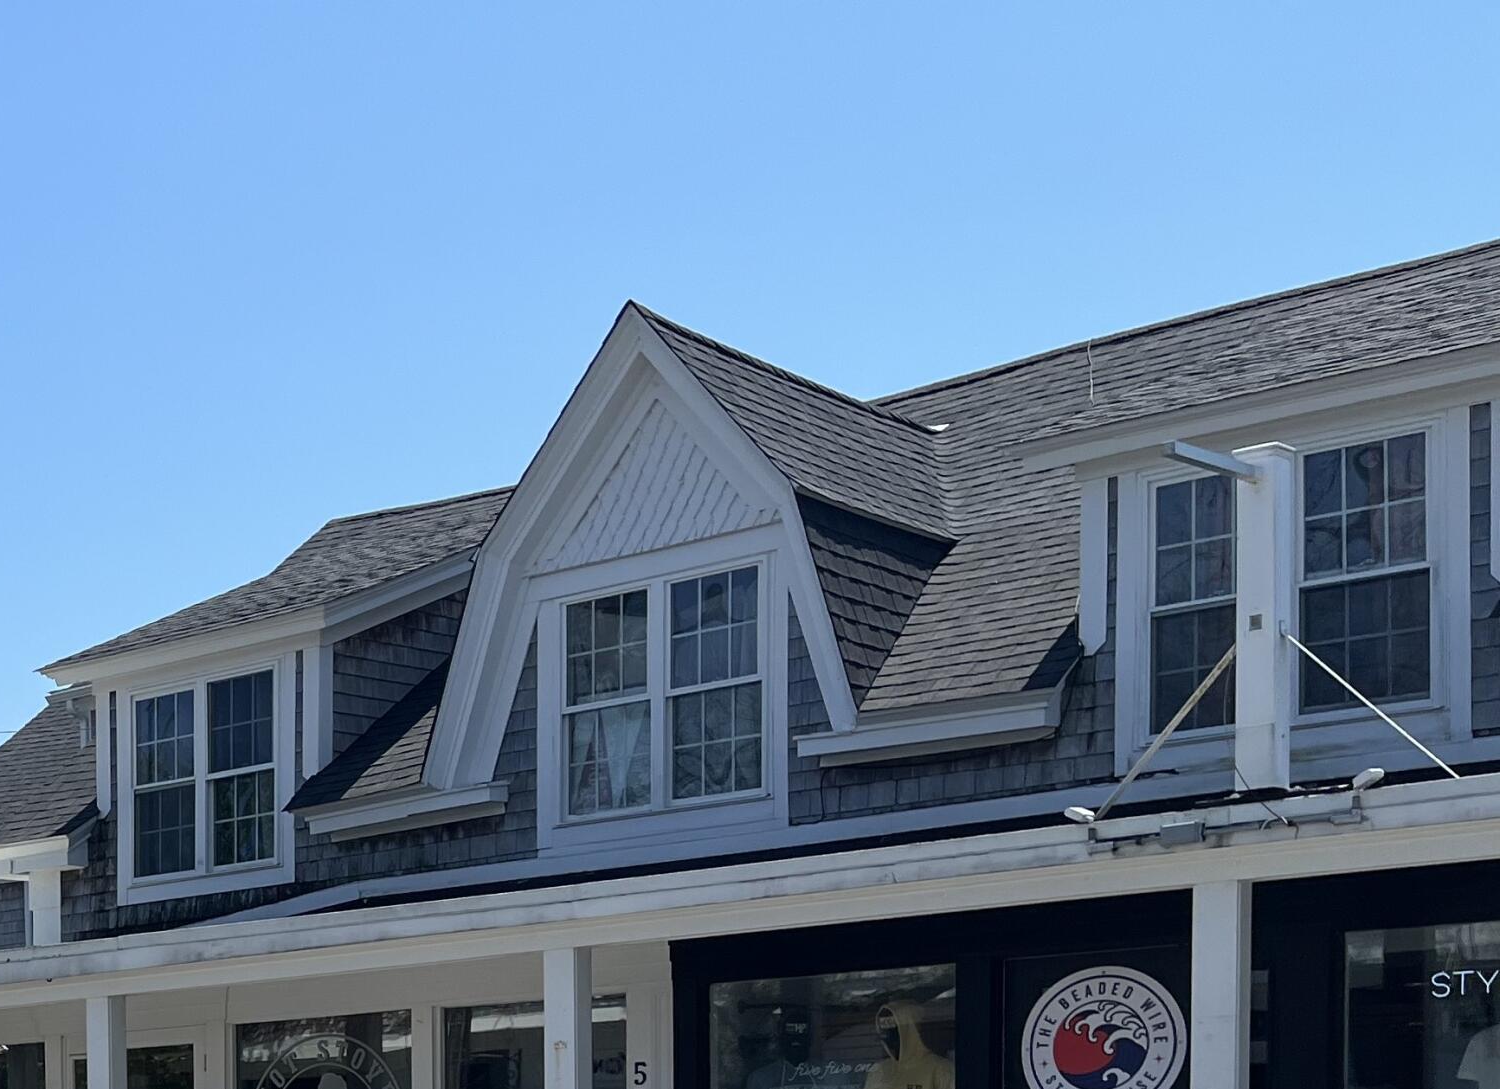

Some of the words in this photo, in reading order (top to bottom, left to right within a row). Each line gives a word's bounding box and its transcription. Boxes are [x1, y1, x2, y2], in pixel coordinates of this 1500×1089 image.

[1036, 1015, 1057, 1049] THE
[1058, 982, 1134, 1010] BEADED
[1140, 998, 1168, 1044] WIRE
[789, 1062, 820, 1081] five
[819, 1060, 851, 1080] five
